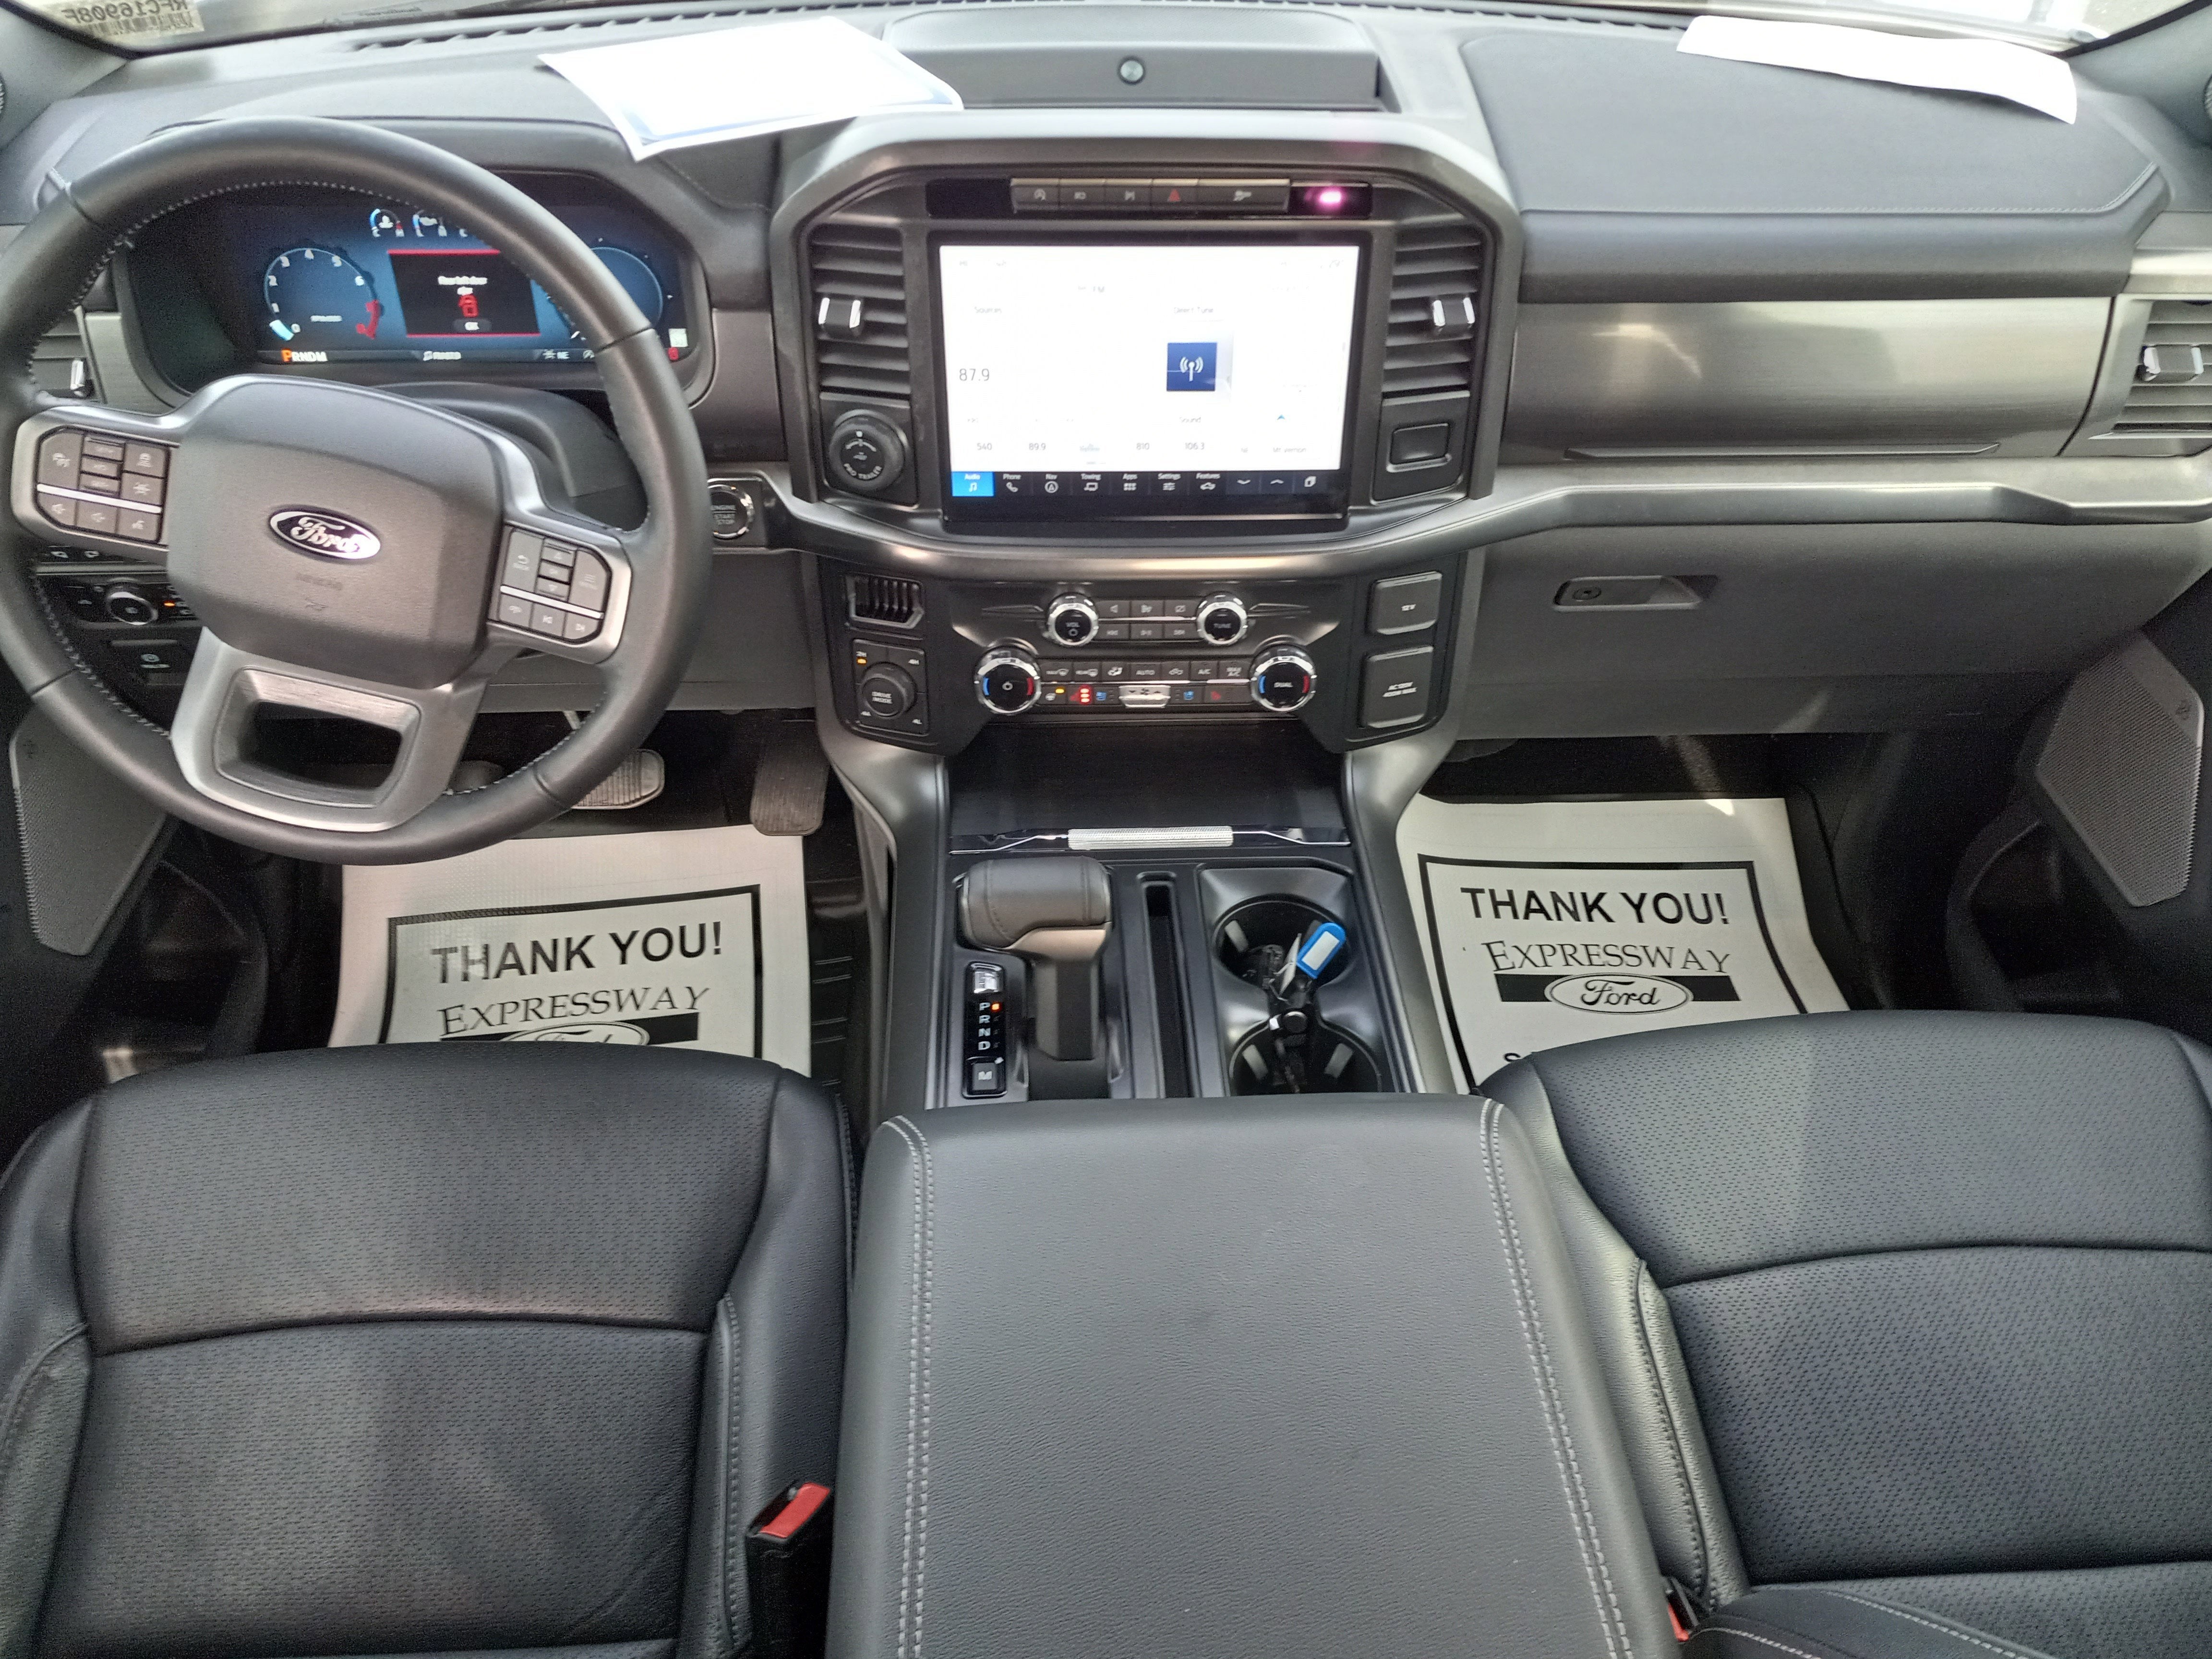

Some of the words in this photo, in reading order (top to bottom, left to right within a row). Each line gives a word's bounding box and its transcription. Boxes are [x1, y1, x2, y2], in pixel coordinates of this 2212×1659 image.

[959, 368, 990, 381] 87.9
[976, 443, 993, 451] 540
[1028, 443, 1047, 451] 89.9
[1185, 442, 1205, 450] 106.3
[290, 517, 363, 552] Ford
[1460, 887, 1614, 924] THANK
[1620, 891, 1730, 926] YOU!
[431, 934, 595, 983] THANK
[608, 921, 722, 965] YOU!
[1580, 979, 1661, 1008] Ford
[979, 1002, 991, 1011] P
[979, 1015, 991, 1024] R
[978, 1027, 991, 1037] N
[978, 1041, 991, 1051] D
[978, 1070, 993, 1081] M
